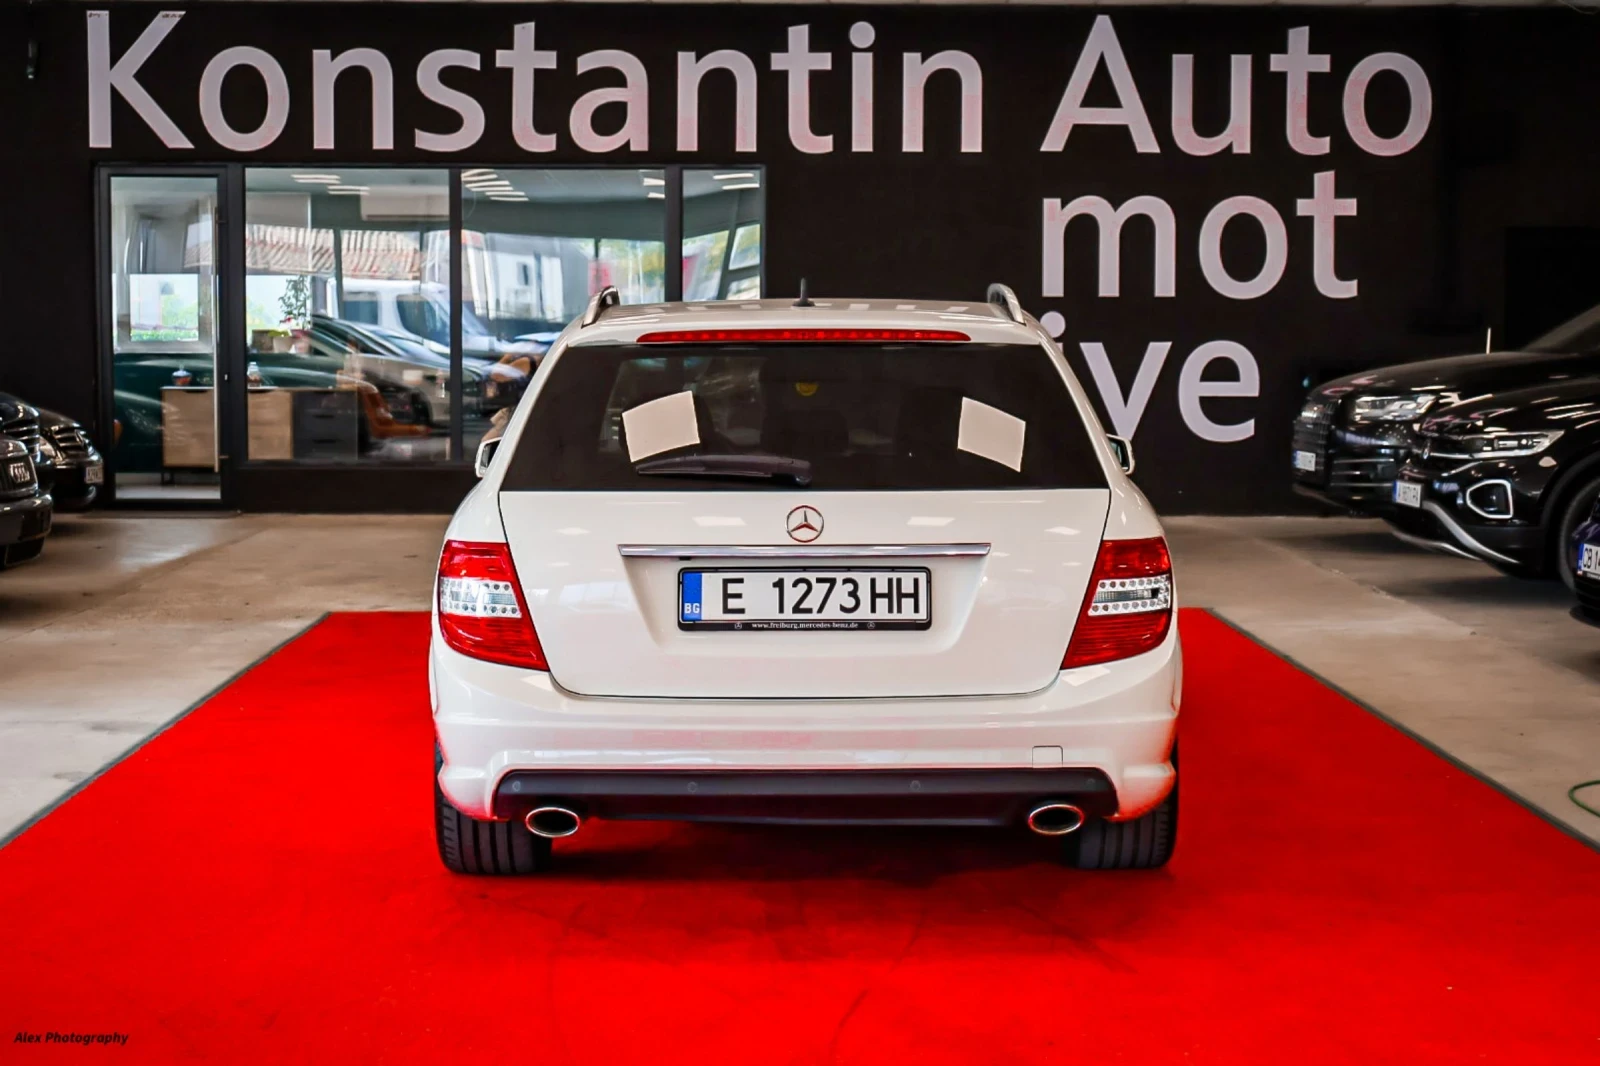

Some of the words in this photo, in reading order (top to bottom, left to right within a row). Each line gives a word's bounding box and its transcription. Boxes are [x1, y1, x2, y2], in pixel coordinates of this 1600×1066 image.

[87, 11, 982, 154] Konstantin
[1040, 15, 1432, 156] Auto
[1042, 171, 1357, 299] mot
[683, 602, 701, 615] BG
[723, 577, 746, 614] E
[772, 577, 861, 614] 1273
[869, 577, 920, 614] HH
